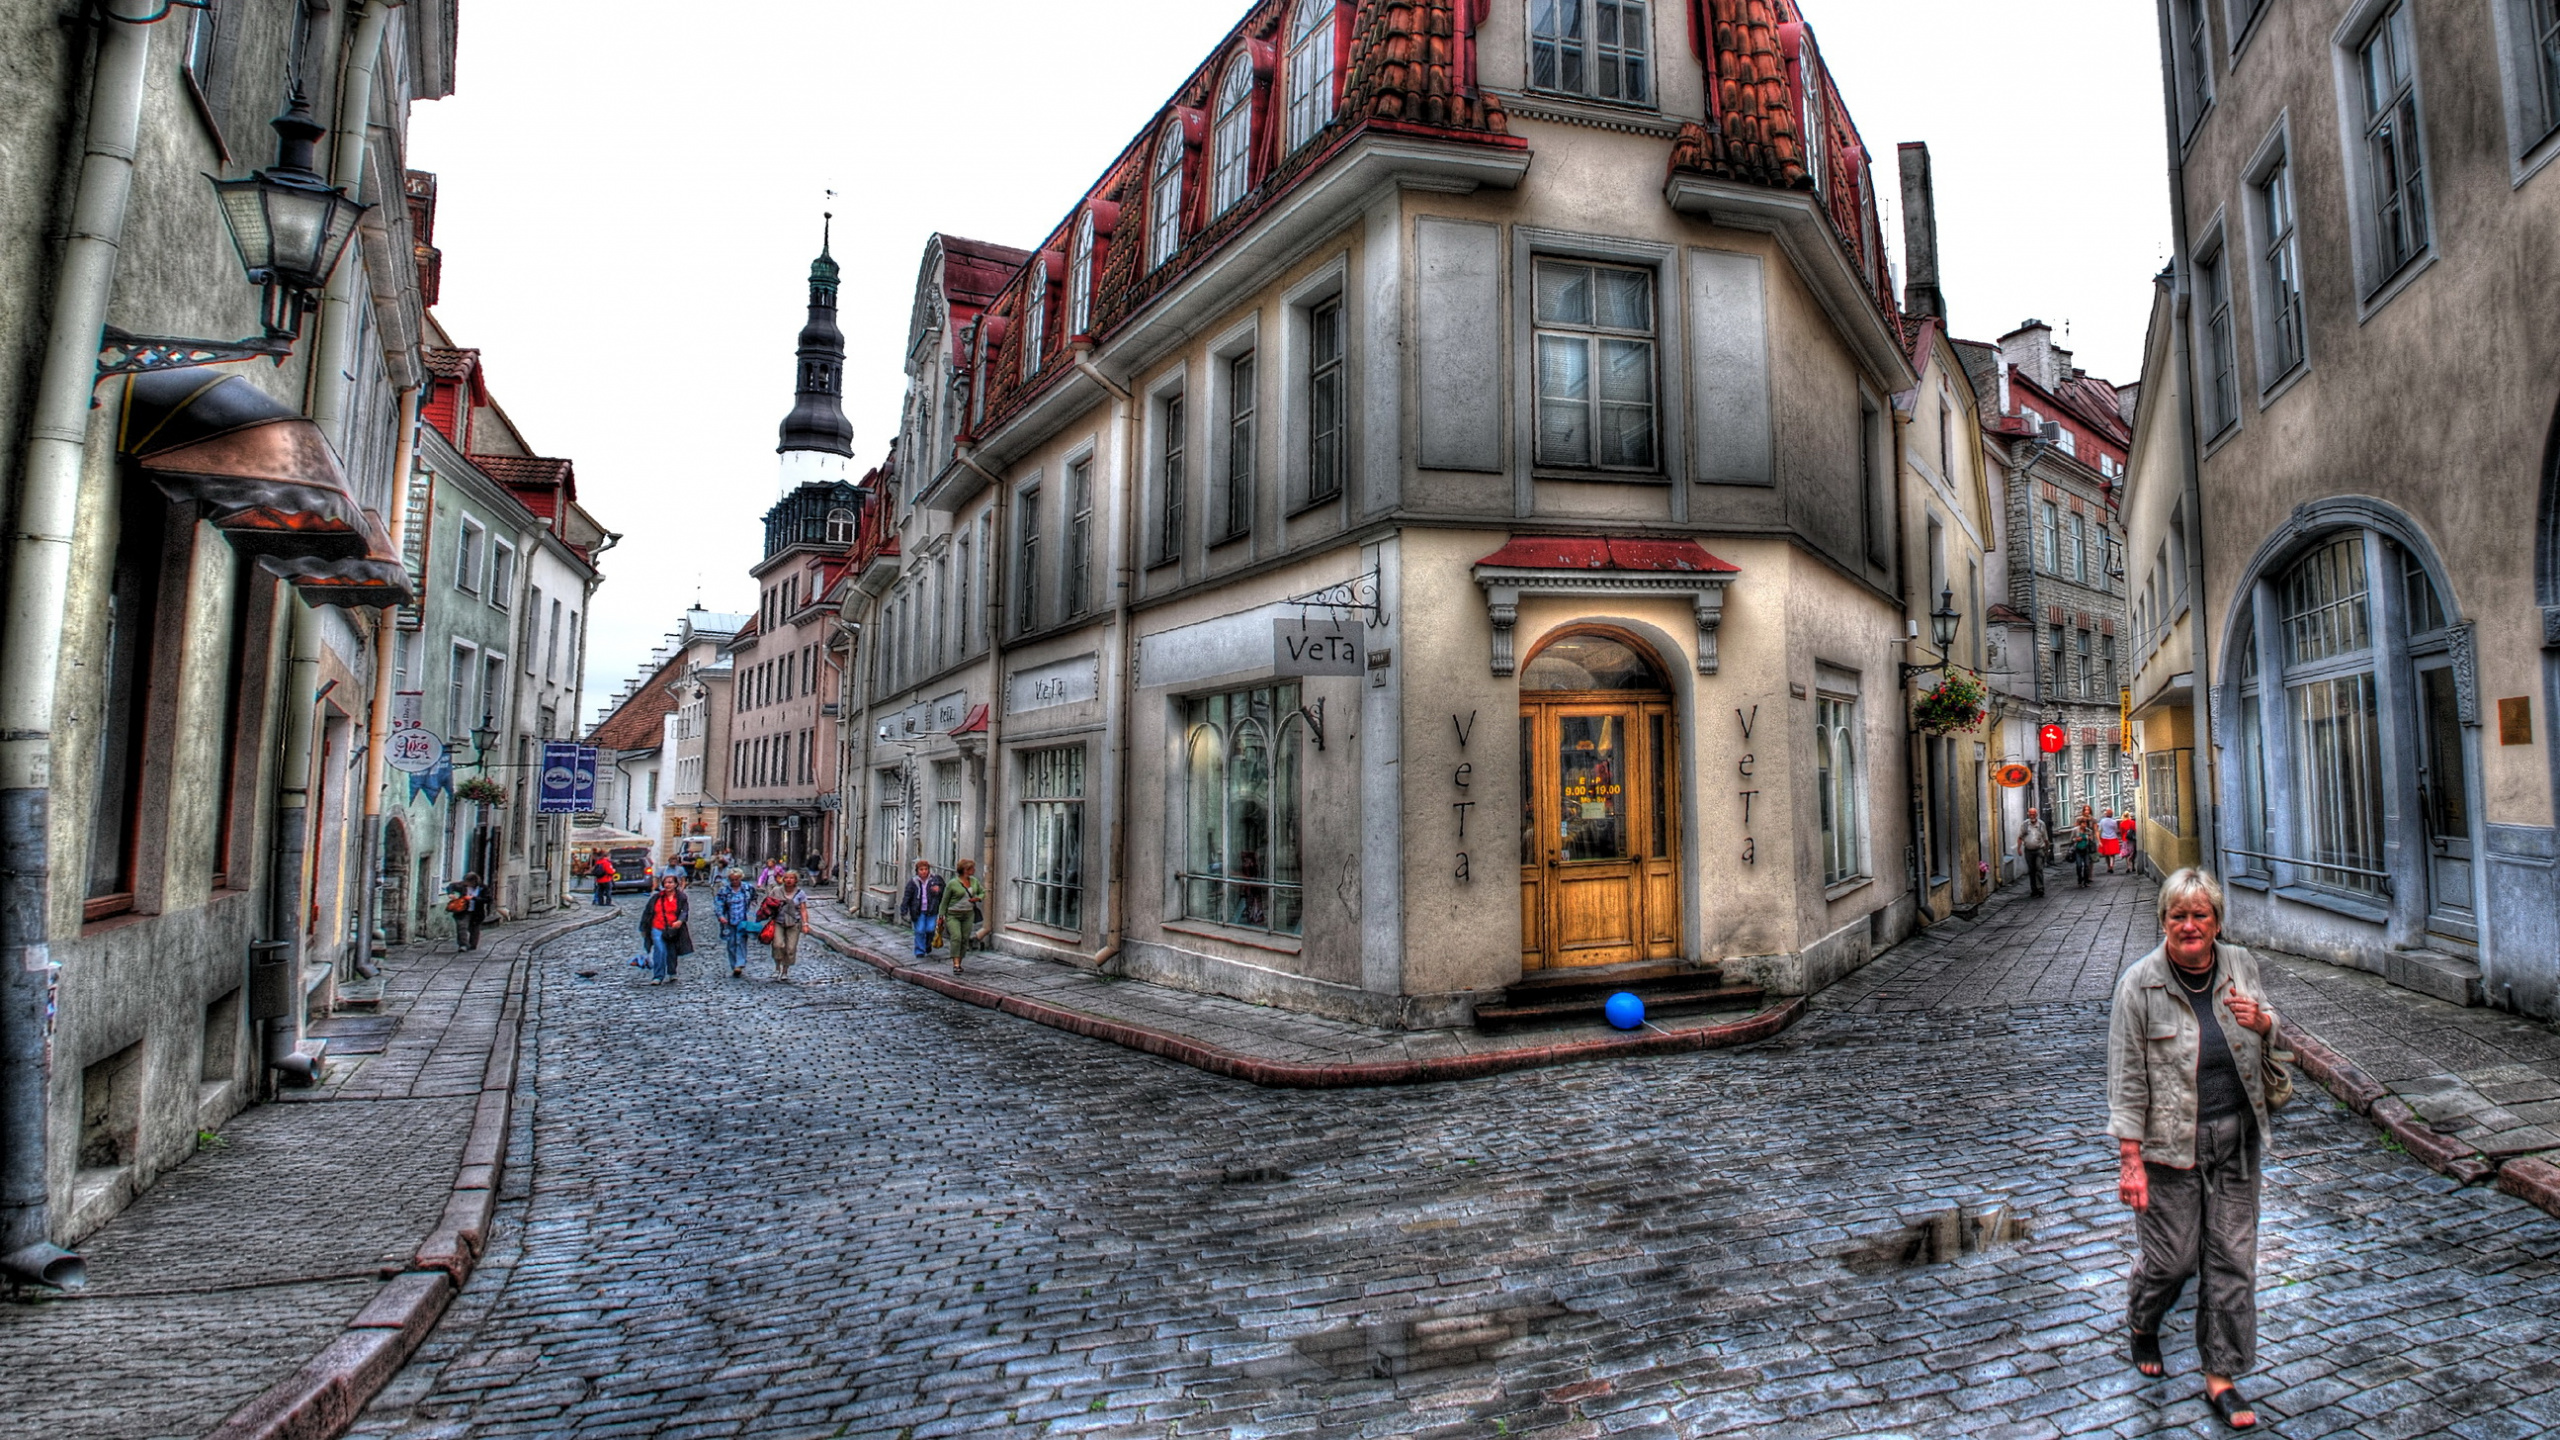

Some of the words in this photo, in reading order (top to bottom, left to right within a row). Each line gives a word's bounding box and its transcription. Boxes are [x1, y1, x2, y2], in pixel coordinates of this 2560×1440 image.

[1286, 636, 1355, 664] VeTa
[1035, 677, 1067, 700] VeTa
[1451, 709, 1478, 882] VeTa
[1565, 786, 1586, 796] 9.00
[1595, 784, 1621, 795] 19.00
[1735, 704, 1760, 865] VeTa
